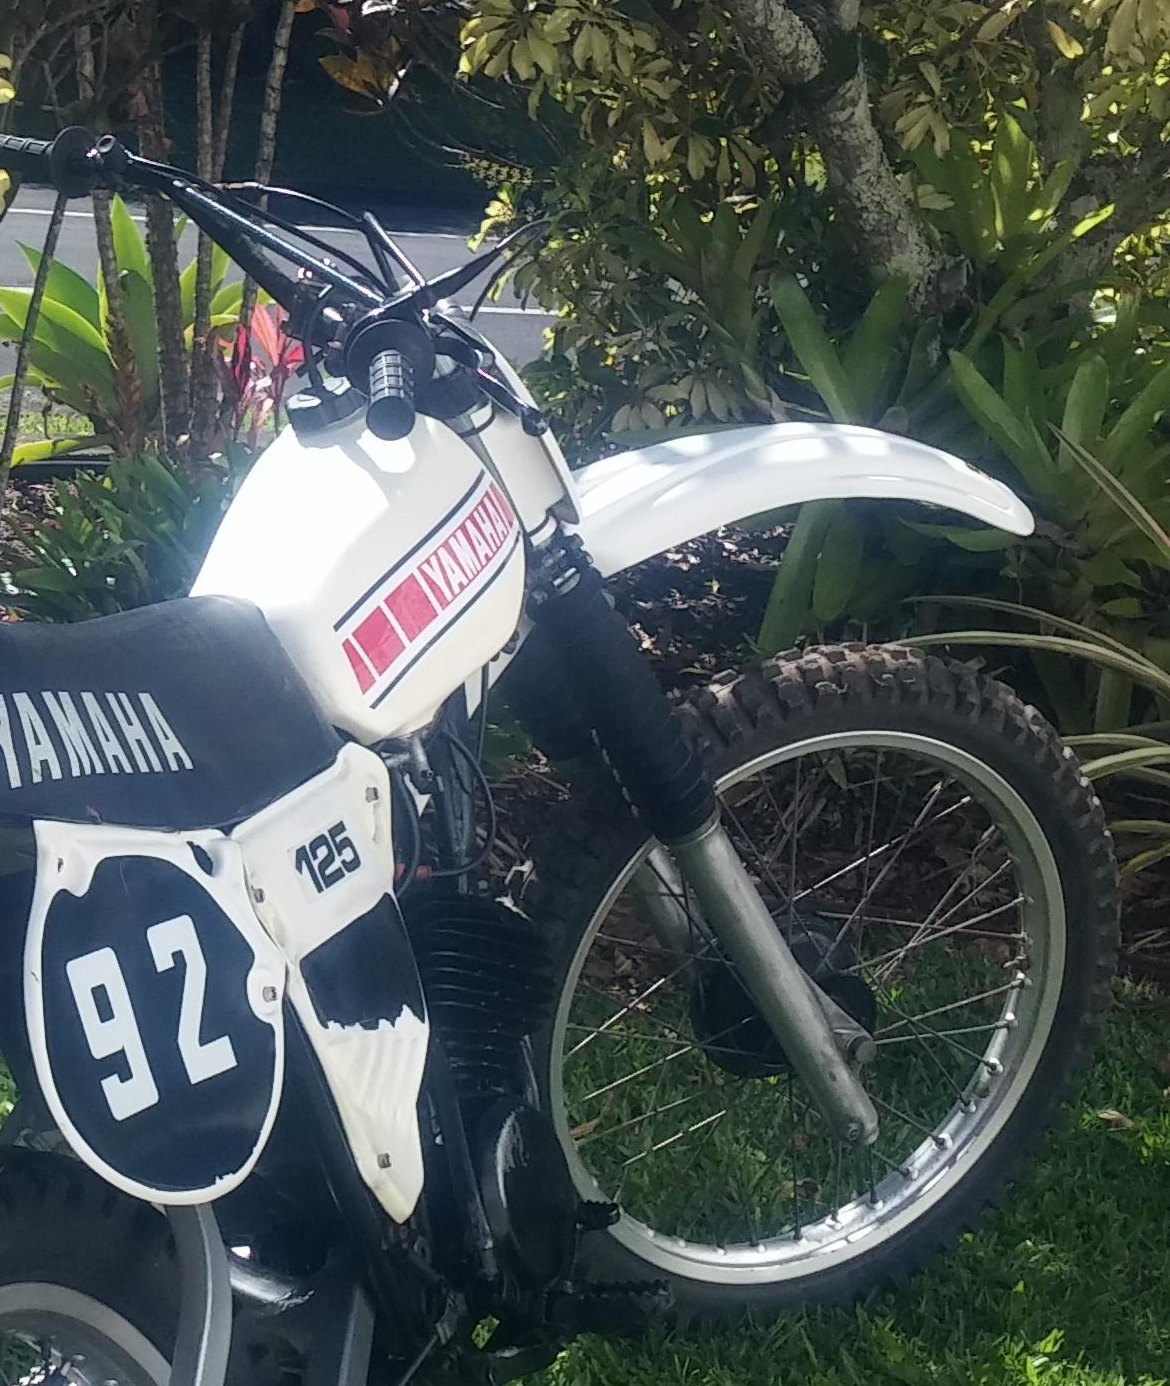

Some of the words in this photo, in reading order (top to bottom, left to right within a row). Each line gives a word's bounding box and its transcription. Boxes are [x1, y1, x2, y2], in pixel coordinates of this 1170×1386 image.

[418, 495, 510, 603] YAMAHA
[295, 820, 362, 894] 125
[66, 914, 238, 1121] 92
